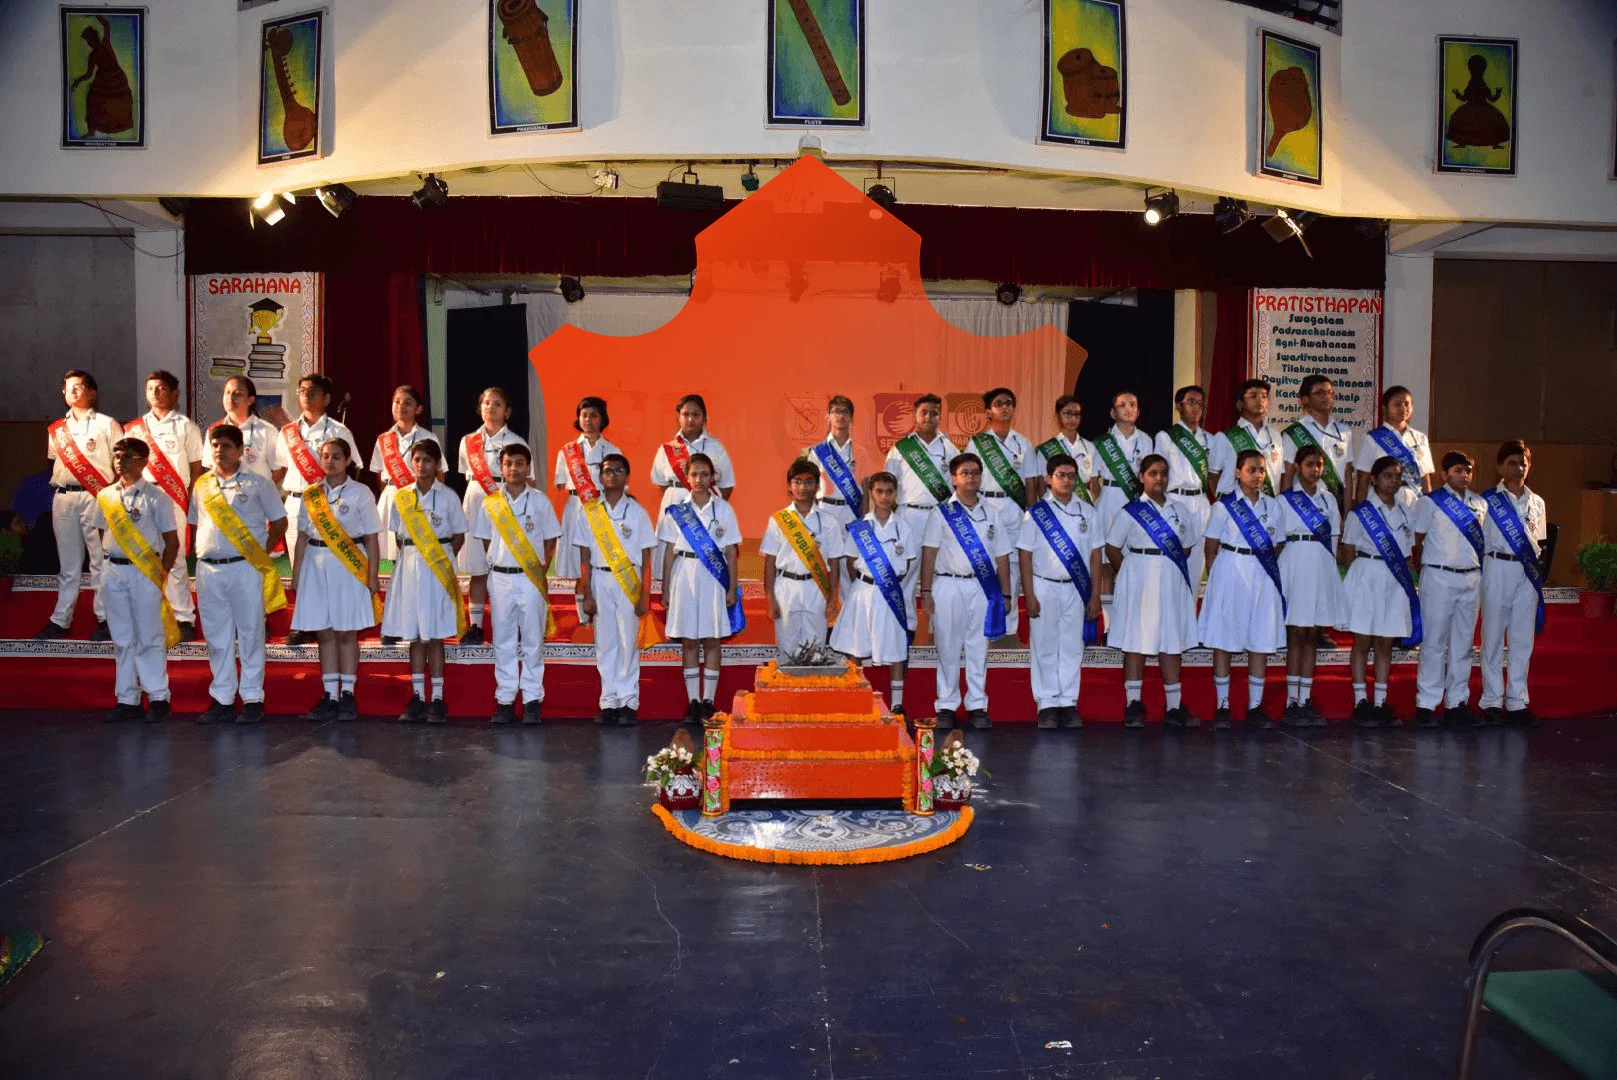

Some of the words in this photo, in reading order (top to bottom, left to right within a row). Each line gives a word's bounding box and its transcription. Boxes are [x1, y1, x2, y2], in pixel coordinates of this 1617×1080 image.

[208, 277, 302, 295] SARAHANA
[1256, 294, 1382, 314] PRATISTHAPAN
[64, 446, 86, 474] PUBLIC
[295, 447, 316, 476] PUBLIC
[909, 450, 929, 472] DELHI
[1180, 436, 1202, 459] DELHI
[825, 454, 845, 478] DELHI
[1103, 438, 1120, 463] DELHI
[1116, 464, 1137, 491] PUBLIC
[163, 474, 186, 502] SCHOOL
[1444, 496, 1467, 520] DELHI
[1487, 494, 1507, 518] DELHI
[1501, 518, 1525, 548] PUBLIC
[315, 511, 339, 540] PUBLIC
[337, 541, 363, 570] SCHOOL
[1034, 507, 1054, 532] DELHI
[1050, 530, 1074, 560] PUBLIC
[1138, 509, 1160, 532] DELHI
[1158, 532, 1180, 558] PUBLIC
[1230, 500, 1251, 524] DELHI
[1247, 525, 1270, 554] PUBLIC
[1360, 506, 1379, 531] DELHI
[1376, 531, 1396, 561] PUBLIC
[701, 543, 724, 573] SCHOOL
[792, 531, 815, 562] PUBLIC
[859, 529, 878, 556] DELHI
[872, 557, 894, 588] PUBLIC
[953, 516, 975, 545] PUBLIC
[970, 547, 990, 580] SCHOOL
